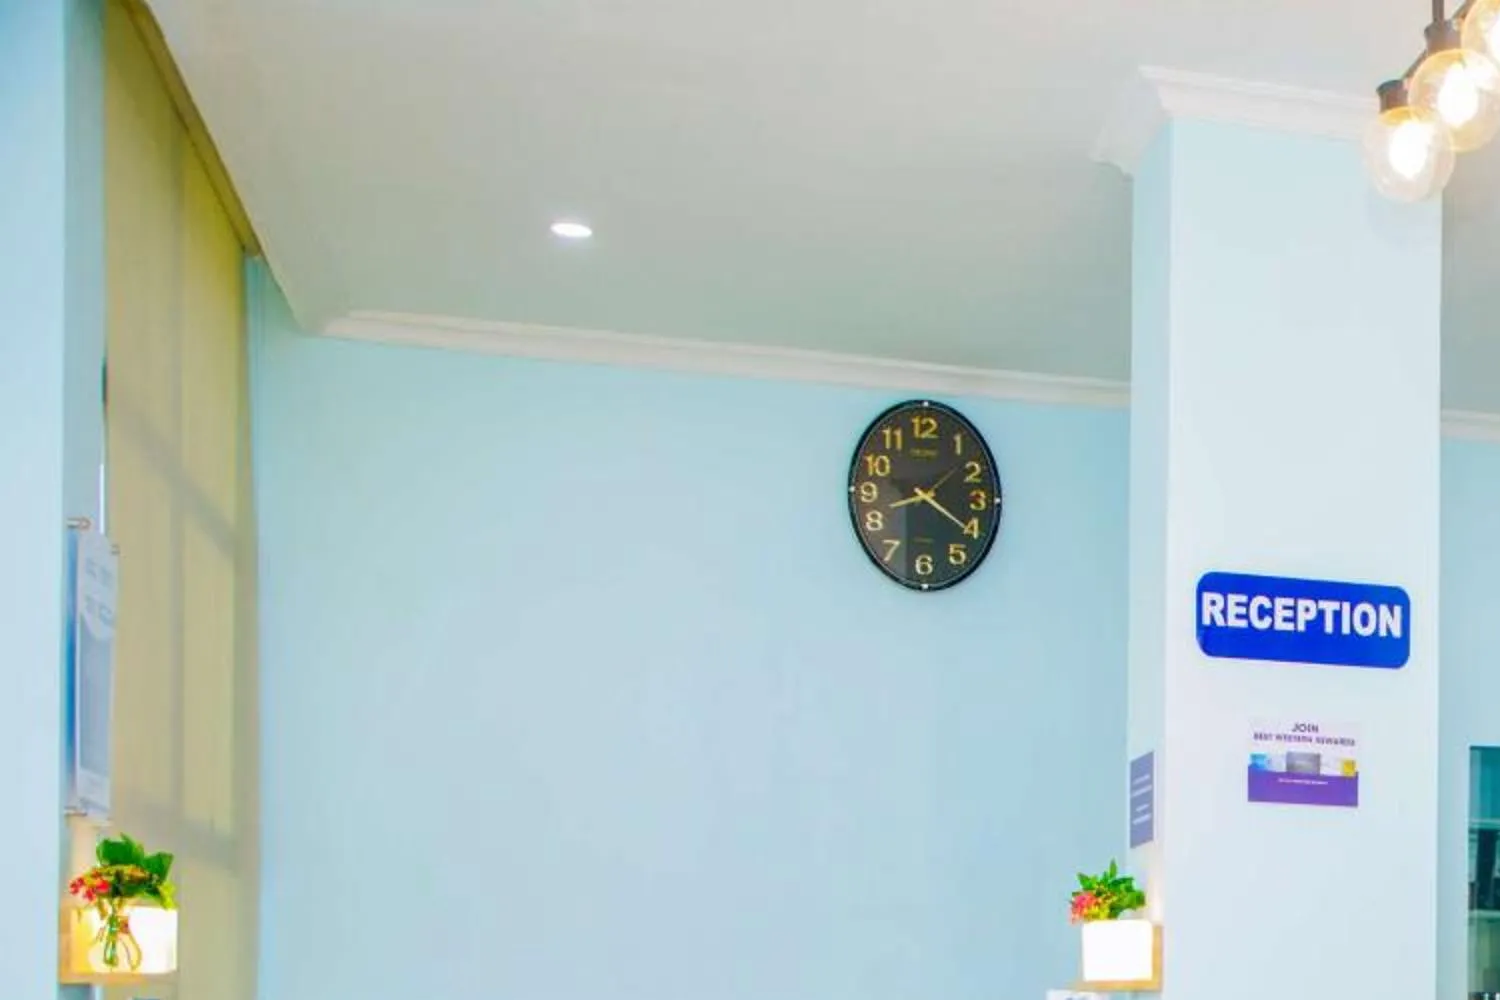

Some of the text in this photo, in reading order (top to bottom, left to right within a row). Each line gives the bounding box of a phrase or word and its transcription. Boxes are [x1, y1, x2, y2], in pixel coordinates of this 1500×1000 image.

[911, 415, 938, 439] 12
[882, 427, 903, 450] 11
[953, 434, 962, 455] 1
[865, 454, 890, 476] 10
[964, 461, 981, 482] 2
[860, 481, 878, 502] 9
[969, 489, 986, 511] 3
[865, 511, 883, 531] 8
[963, 517, 979, 539] 4
[883, 540, 900, 562] 7
[949, 544, 966, 565] 5
[915, 554, 933, 575] 6
[1201, 591, 1402, 638] RECEPTION
[1292, 723, 1319, 733] JOIN
